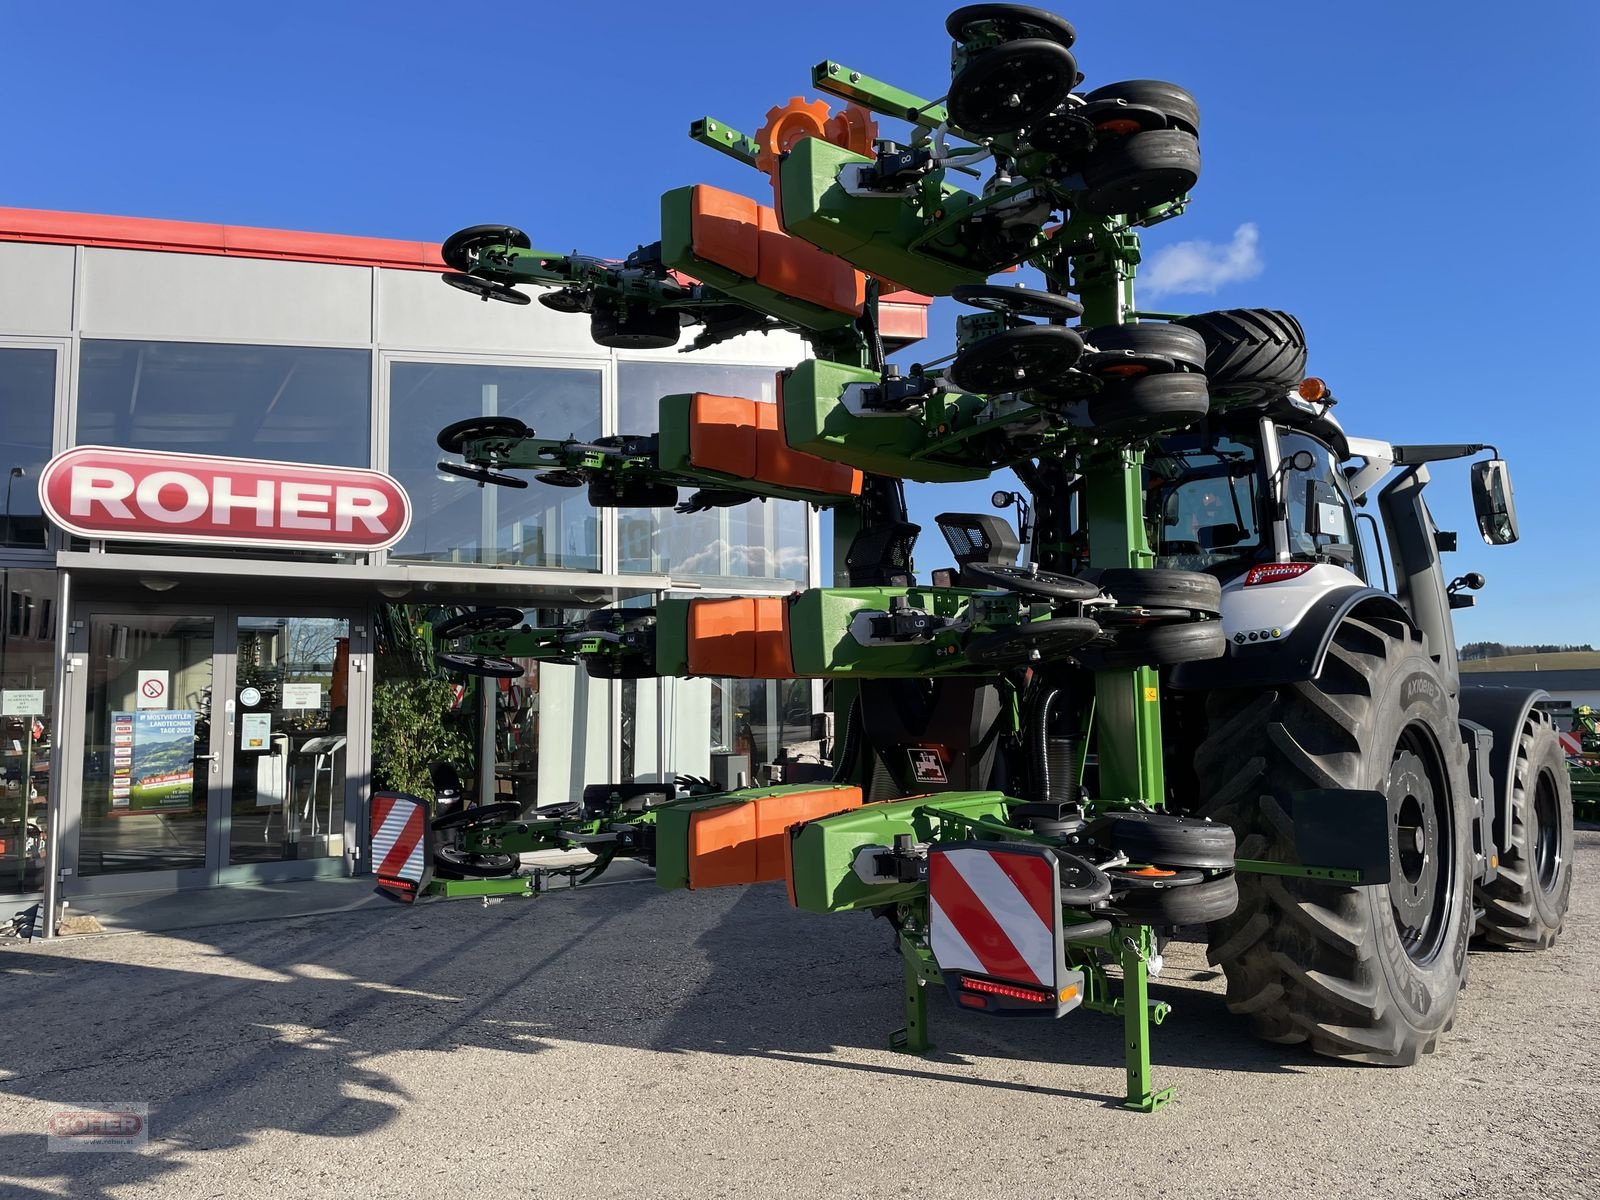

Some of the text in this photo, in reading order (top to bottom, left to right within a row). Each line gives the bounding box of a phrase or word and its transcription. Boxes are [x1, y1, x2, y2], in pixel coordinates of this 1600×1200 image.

[901, 154, 912, 164] 8
[69, 465, 390, 534] ROHER
[146, 713, 192, 721] MOSTVIERTLER
[150, 720, 192, 728] LANDTECHNIK
